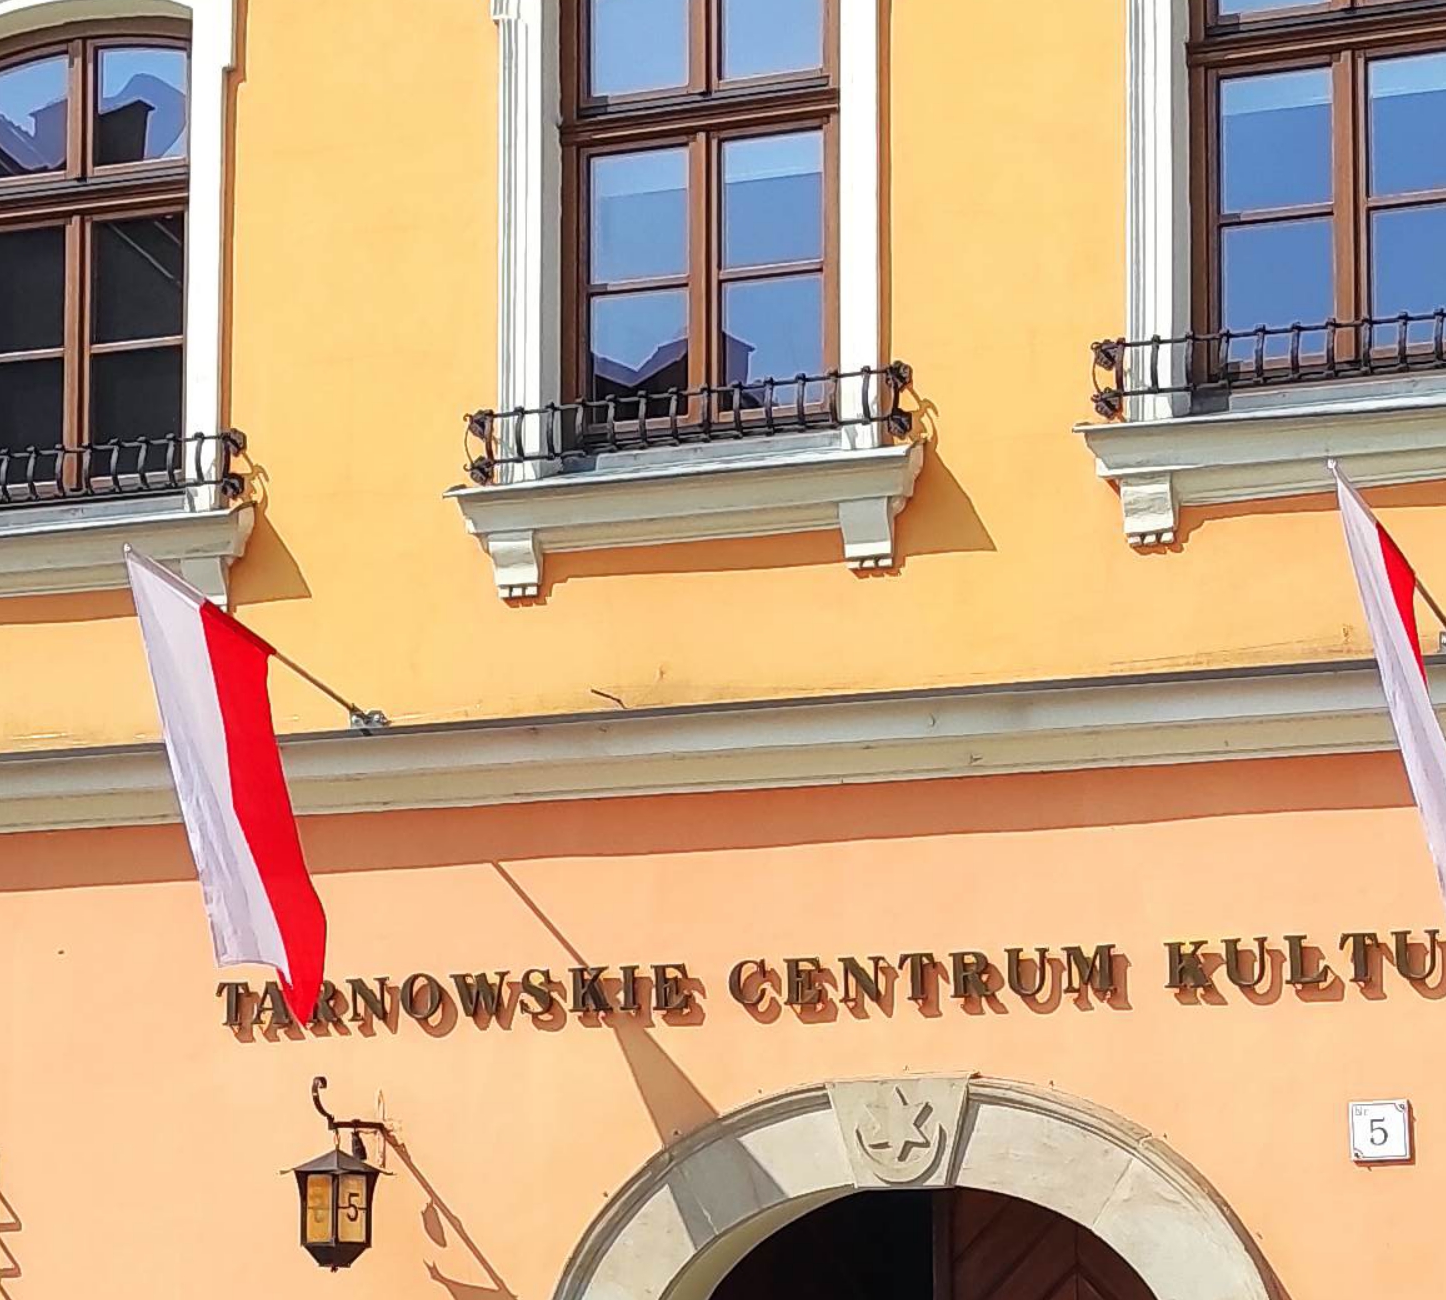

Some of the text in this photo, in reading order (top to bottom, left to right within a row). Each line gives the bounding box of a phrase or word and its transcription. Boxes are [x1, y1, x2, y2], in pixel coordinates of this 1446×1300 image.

[217, 963, 690, 1027] TARNOWSKIE
[728, 944, 1116, 1006] CENTRUM
[1370, 1117, 1388, 1146] 5
[347, 1192, 360, 1222] 5
